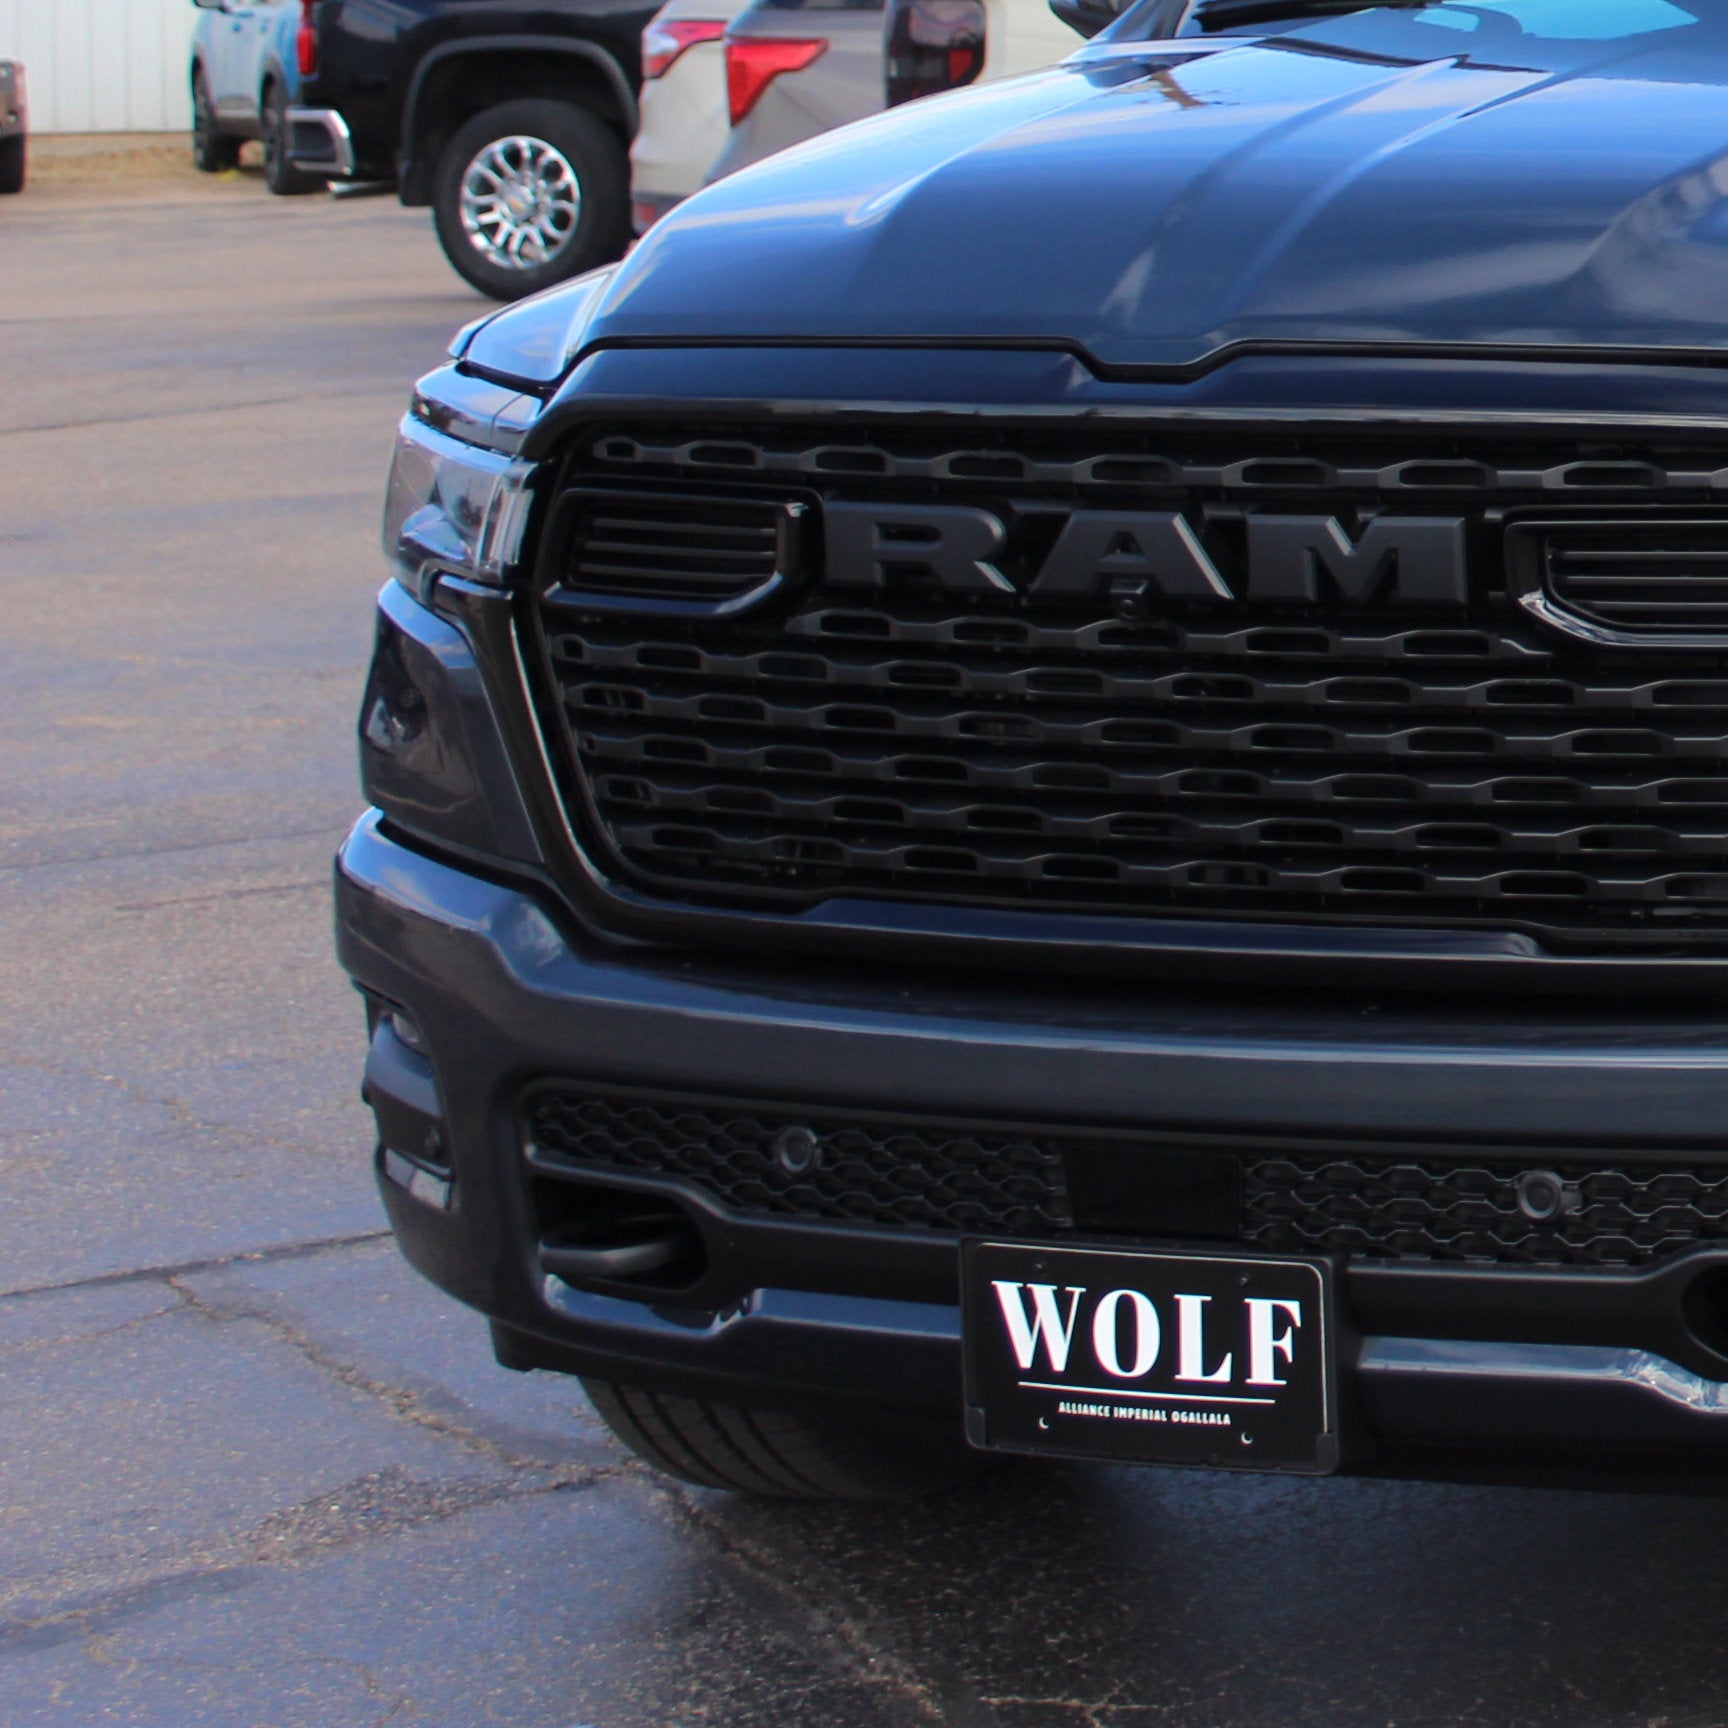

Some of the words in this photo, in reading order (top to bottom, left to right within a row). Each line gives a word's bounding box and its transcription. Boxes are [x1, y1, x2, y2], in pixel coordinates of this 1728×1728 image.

[823, 499, 1467, 604] RAM
[991, 1280, 1301, 1386] WOLF
[1057, 1401, 1111, 1418] ALLIANCE
[1113, 1406, 1168, 1422] IMPERIAL
[1171, 1410, 1231, 1426] OGALLALA
